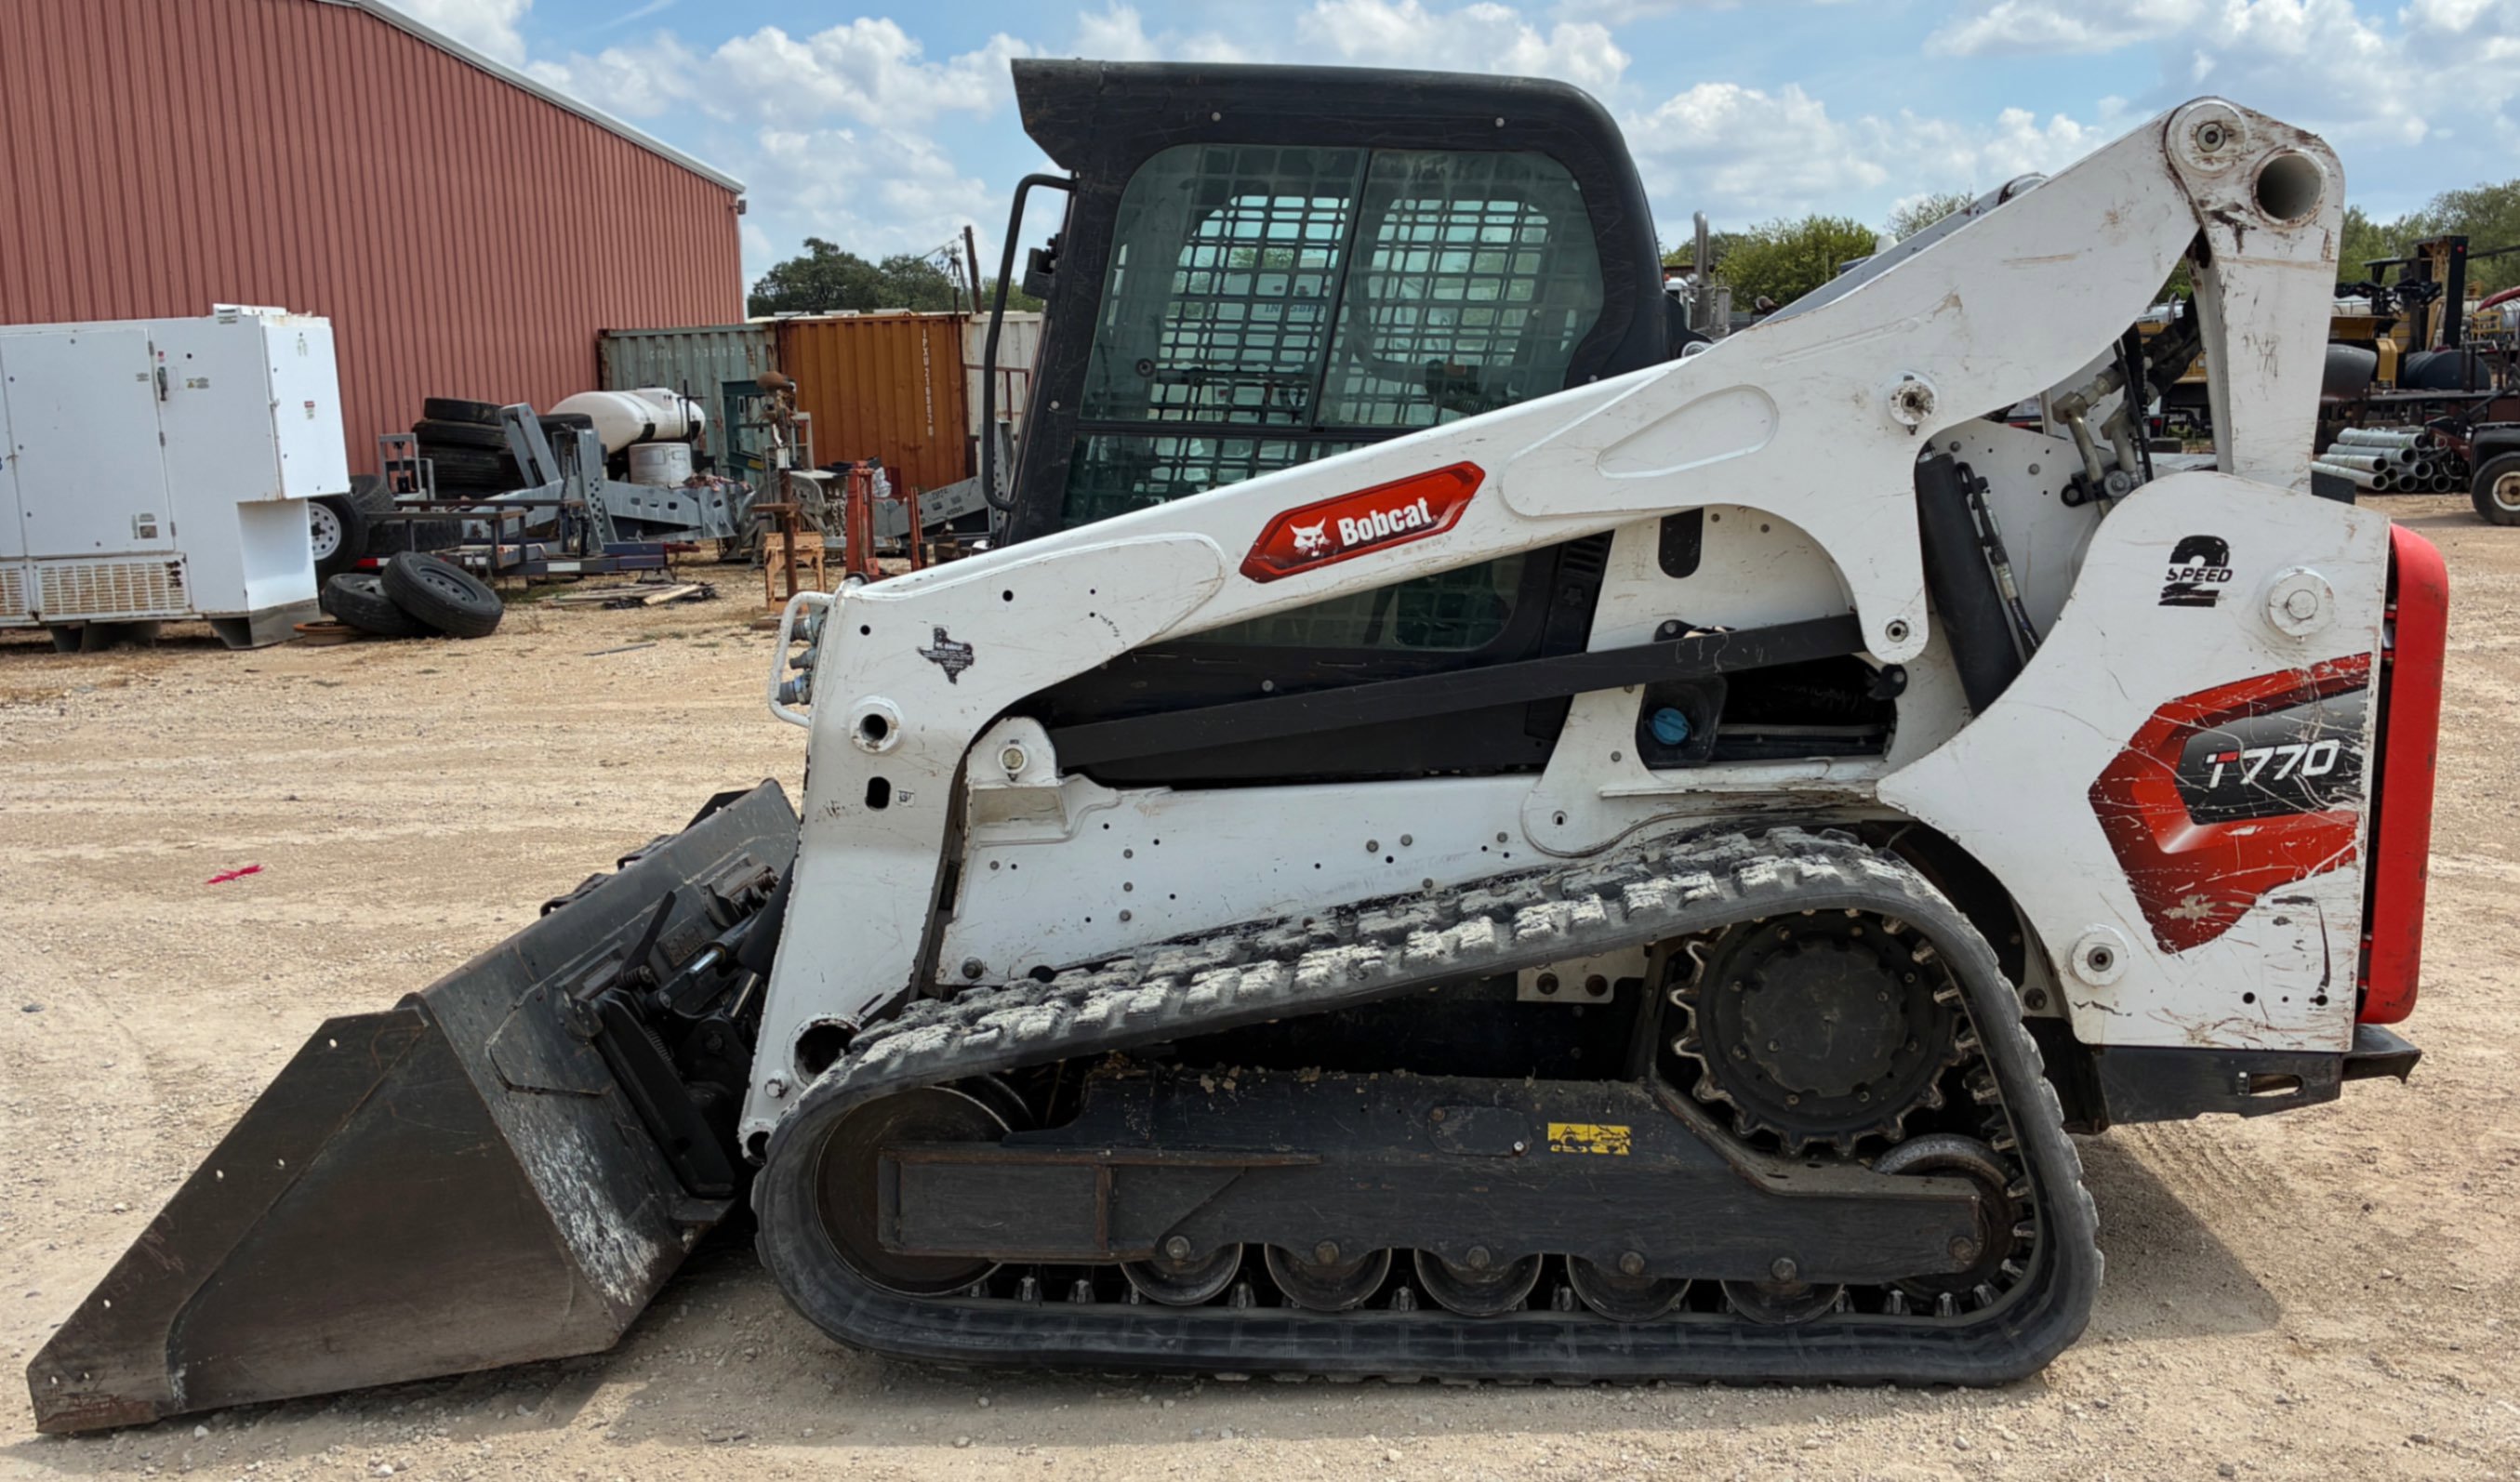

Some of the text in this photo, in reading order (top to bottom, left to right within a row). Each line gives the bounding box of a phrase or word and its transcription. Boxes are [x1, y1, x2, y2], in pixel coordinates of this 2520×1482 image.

[1337, 496, 1432, 547] Bobcat
[2157, 535, 2231, 609] 2
[2165, 567, 2234, 583] SPEED
[2206, 739, 2341, 789] T770
